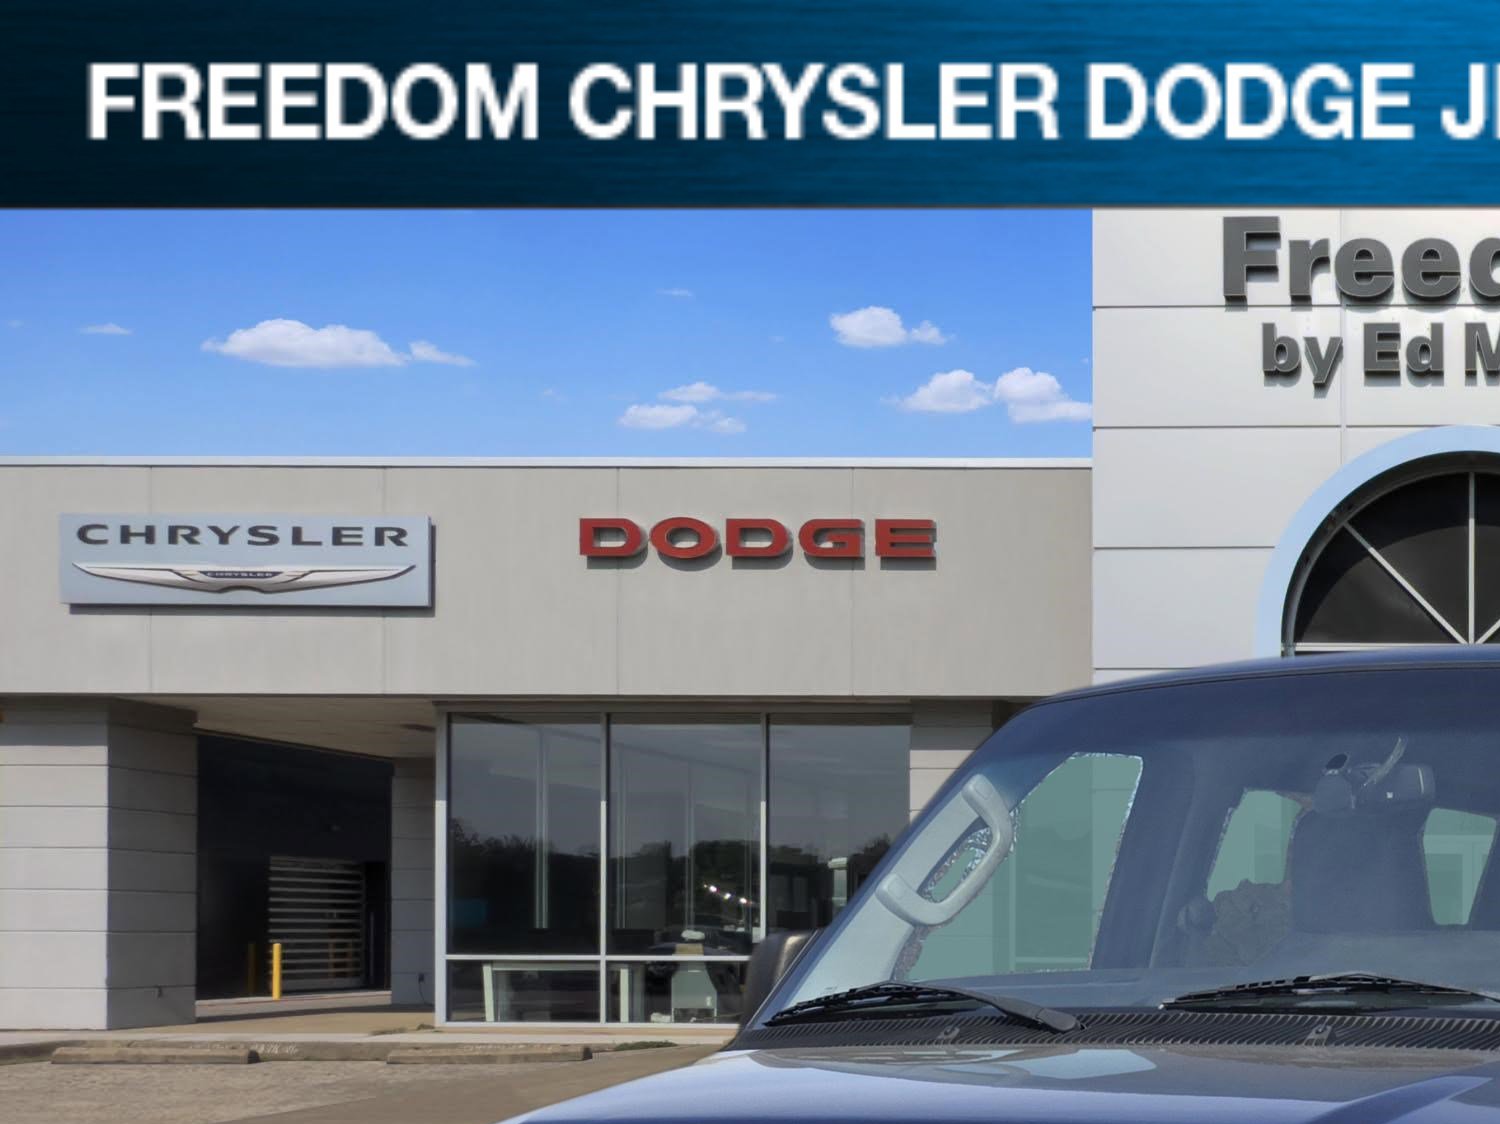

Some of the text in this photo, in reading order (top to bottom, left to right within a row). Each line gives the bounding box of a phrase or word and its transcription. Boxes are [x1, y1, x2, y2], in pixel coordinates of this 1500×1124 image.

[1262, 322, 1343, 384] by
[1364, 322, 1444, 377] Ed
[76, 523, 408, 547] CHRYSLER
[579, 517, 935, 558] DODGE
